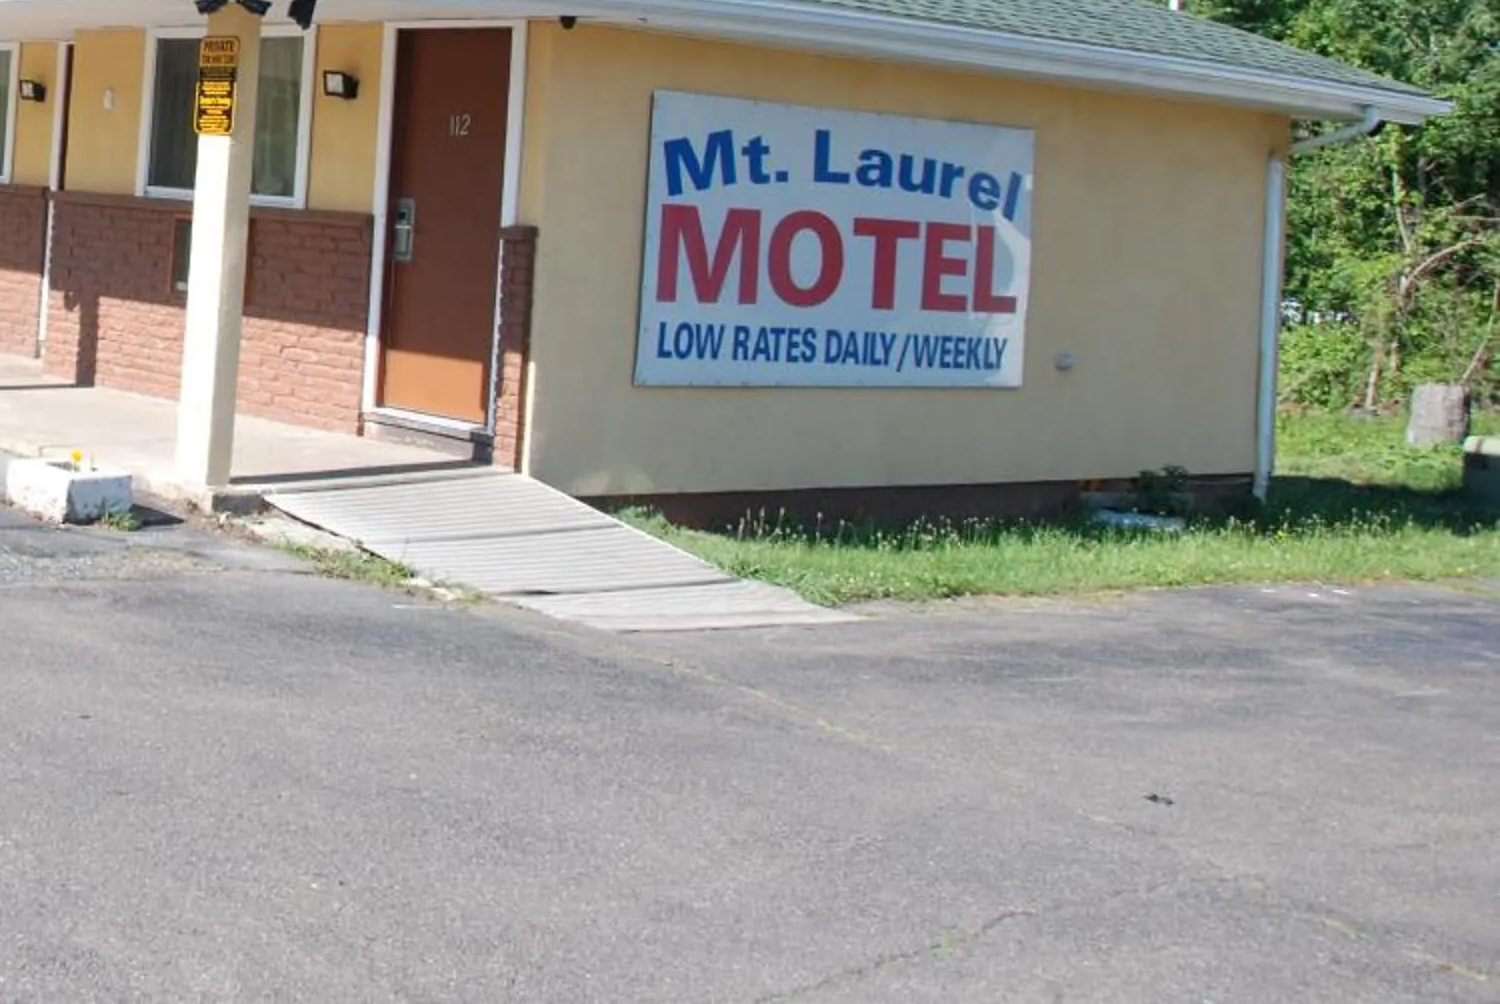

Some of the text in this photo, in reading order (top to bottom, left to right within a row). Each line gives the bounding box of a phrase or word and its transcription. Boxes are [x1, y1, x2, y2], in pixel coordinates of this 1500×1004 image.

[450, 113, 471, 136] 112
[662, 128, 1024, 221] Mt. Laurel
[655, 202, 1018, 314] MOTEL
[656, 321, 726, 361] LOW
[731, 324, 819, 365] RATES
